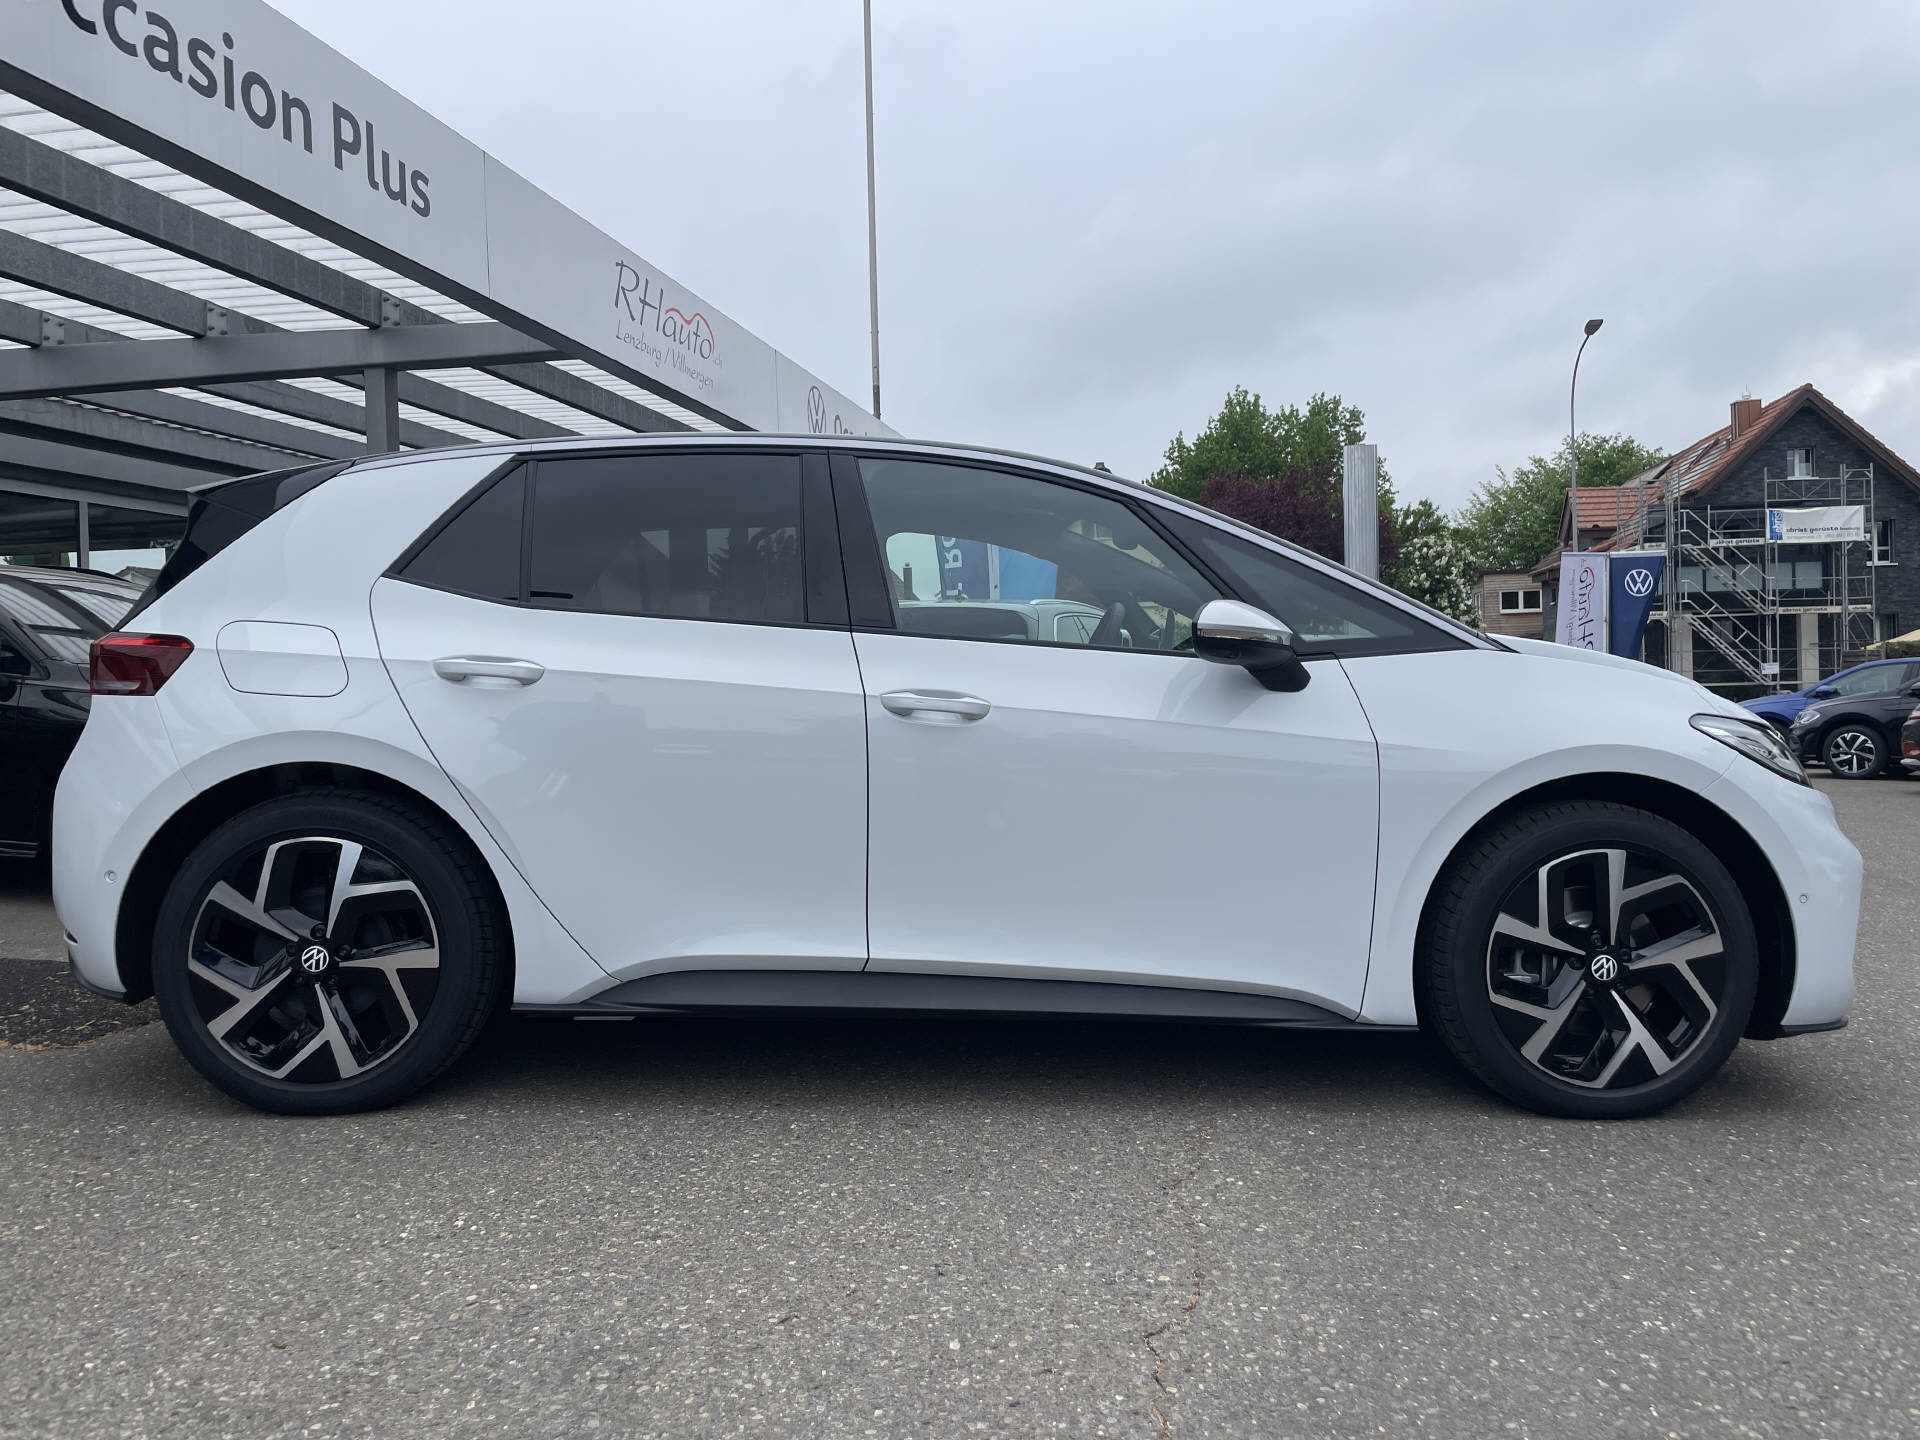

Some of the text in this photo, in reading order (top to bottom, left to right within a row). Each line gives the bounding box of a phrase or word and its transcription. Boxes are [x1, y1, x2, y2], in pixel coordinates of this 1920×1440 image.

[332, 101, 431, 218] Plus
[615, 319, 662, 368] Lenzburg
[1624, 568, 1654, 597] VW
